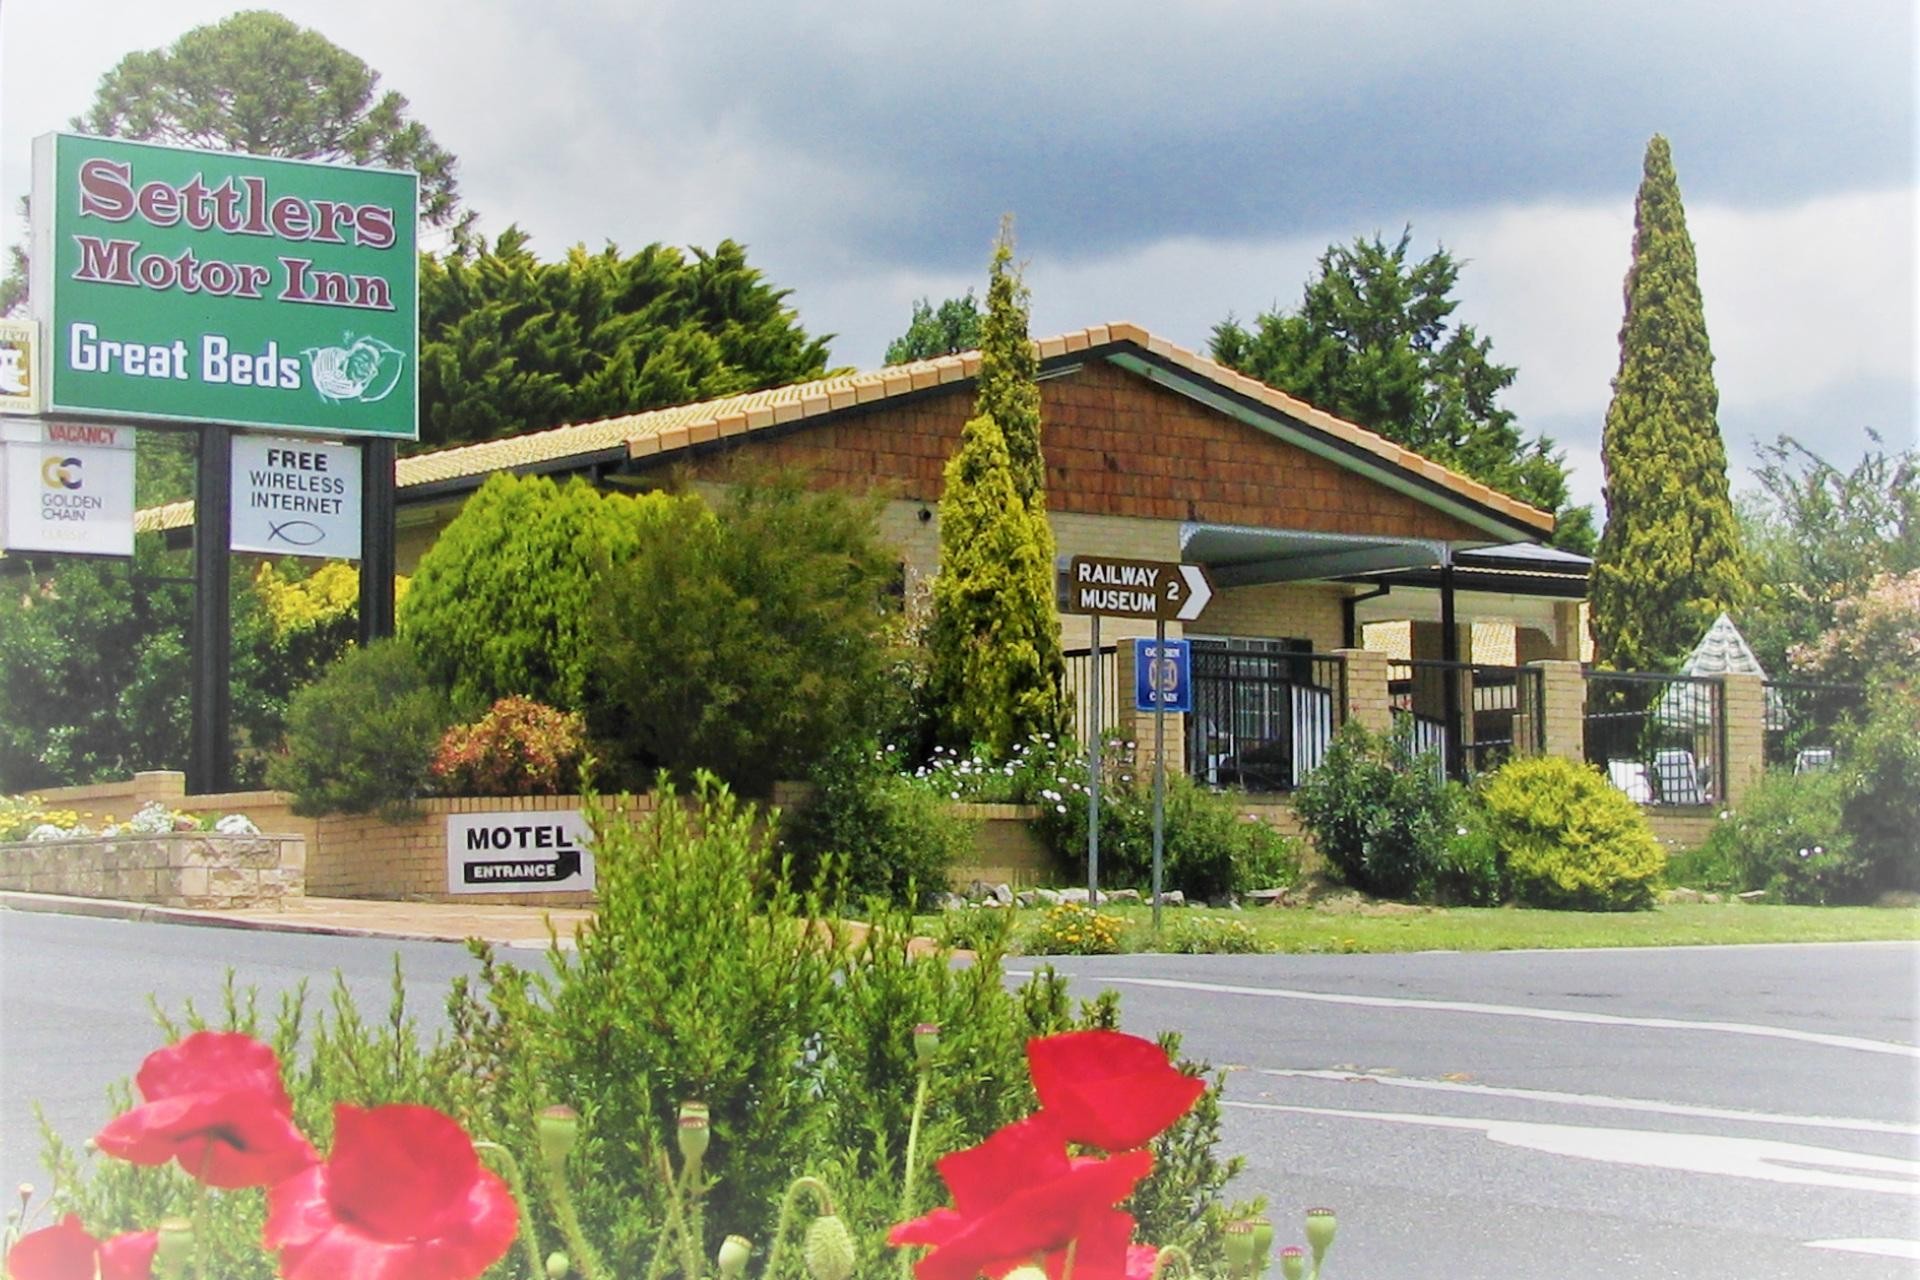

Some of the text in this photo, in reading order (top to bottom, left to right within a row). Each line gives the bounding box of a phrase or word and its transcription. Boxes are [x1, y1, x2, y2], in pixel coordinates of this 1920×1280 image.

[79, 158, 396, 248] Settlers
[72, 235, 396, 310] Motor Inn
[71, 323, 301, 389] Great Beds
[48, 425, 117, 444] VACANCY
[267, 449, 328, 472] FREE
[250, 471, 345, 494] WIRELESS
[41, 493, 102, 509] GOLDEN
[251, 492, 343, 515] INTERNET
[41, 508, 86, 521] CHAIN
[1078, 563, 1159, 588] RAILWAY
[1080, 589, 1157, 613] MUSEUM
[1167, 582, 1180, 600] 2
[467, 825, 573, 850] MOTEL
[473, 864, 557, 879] ENTRANCE
